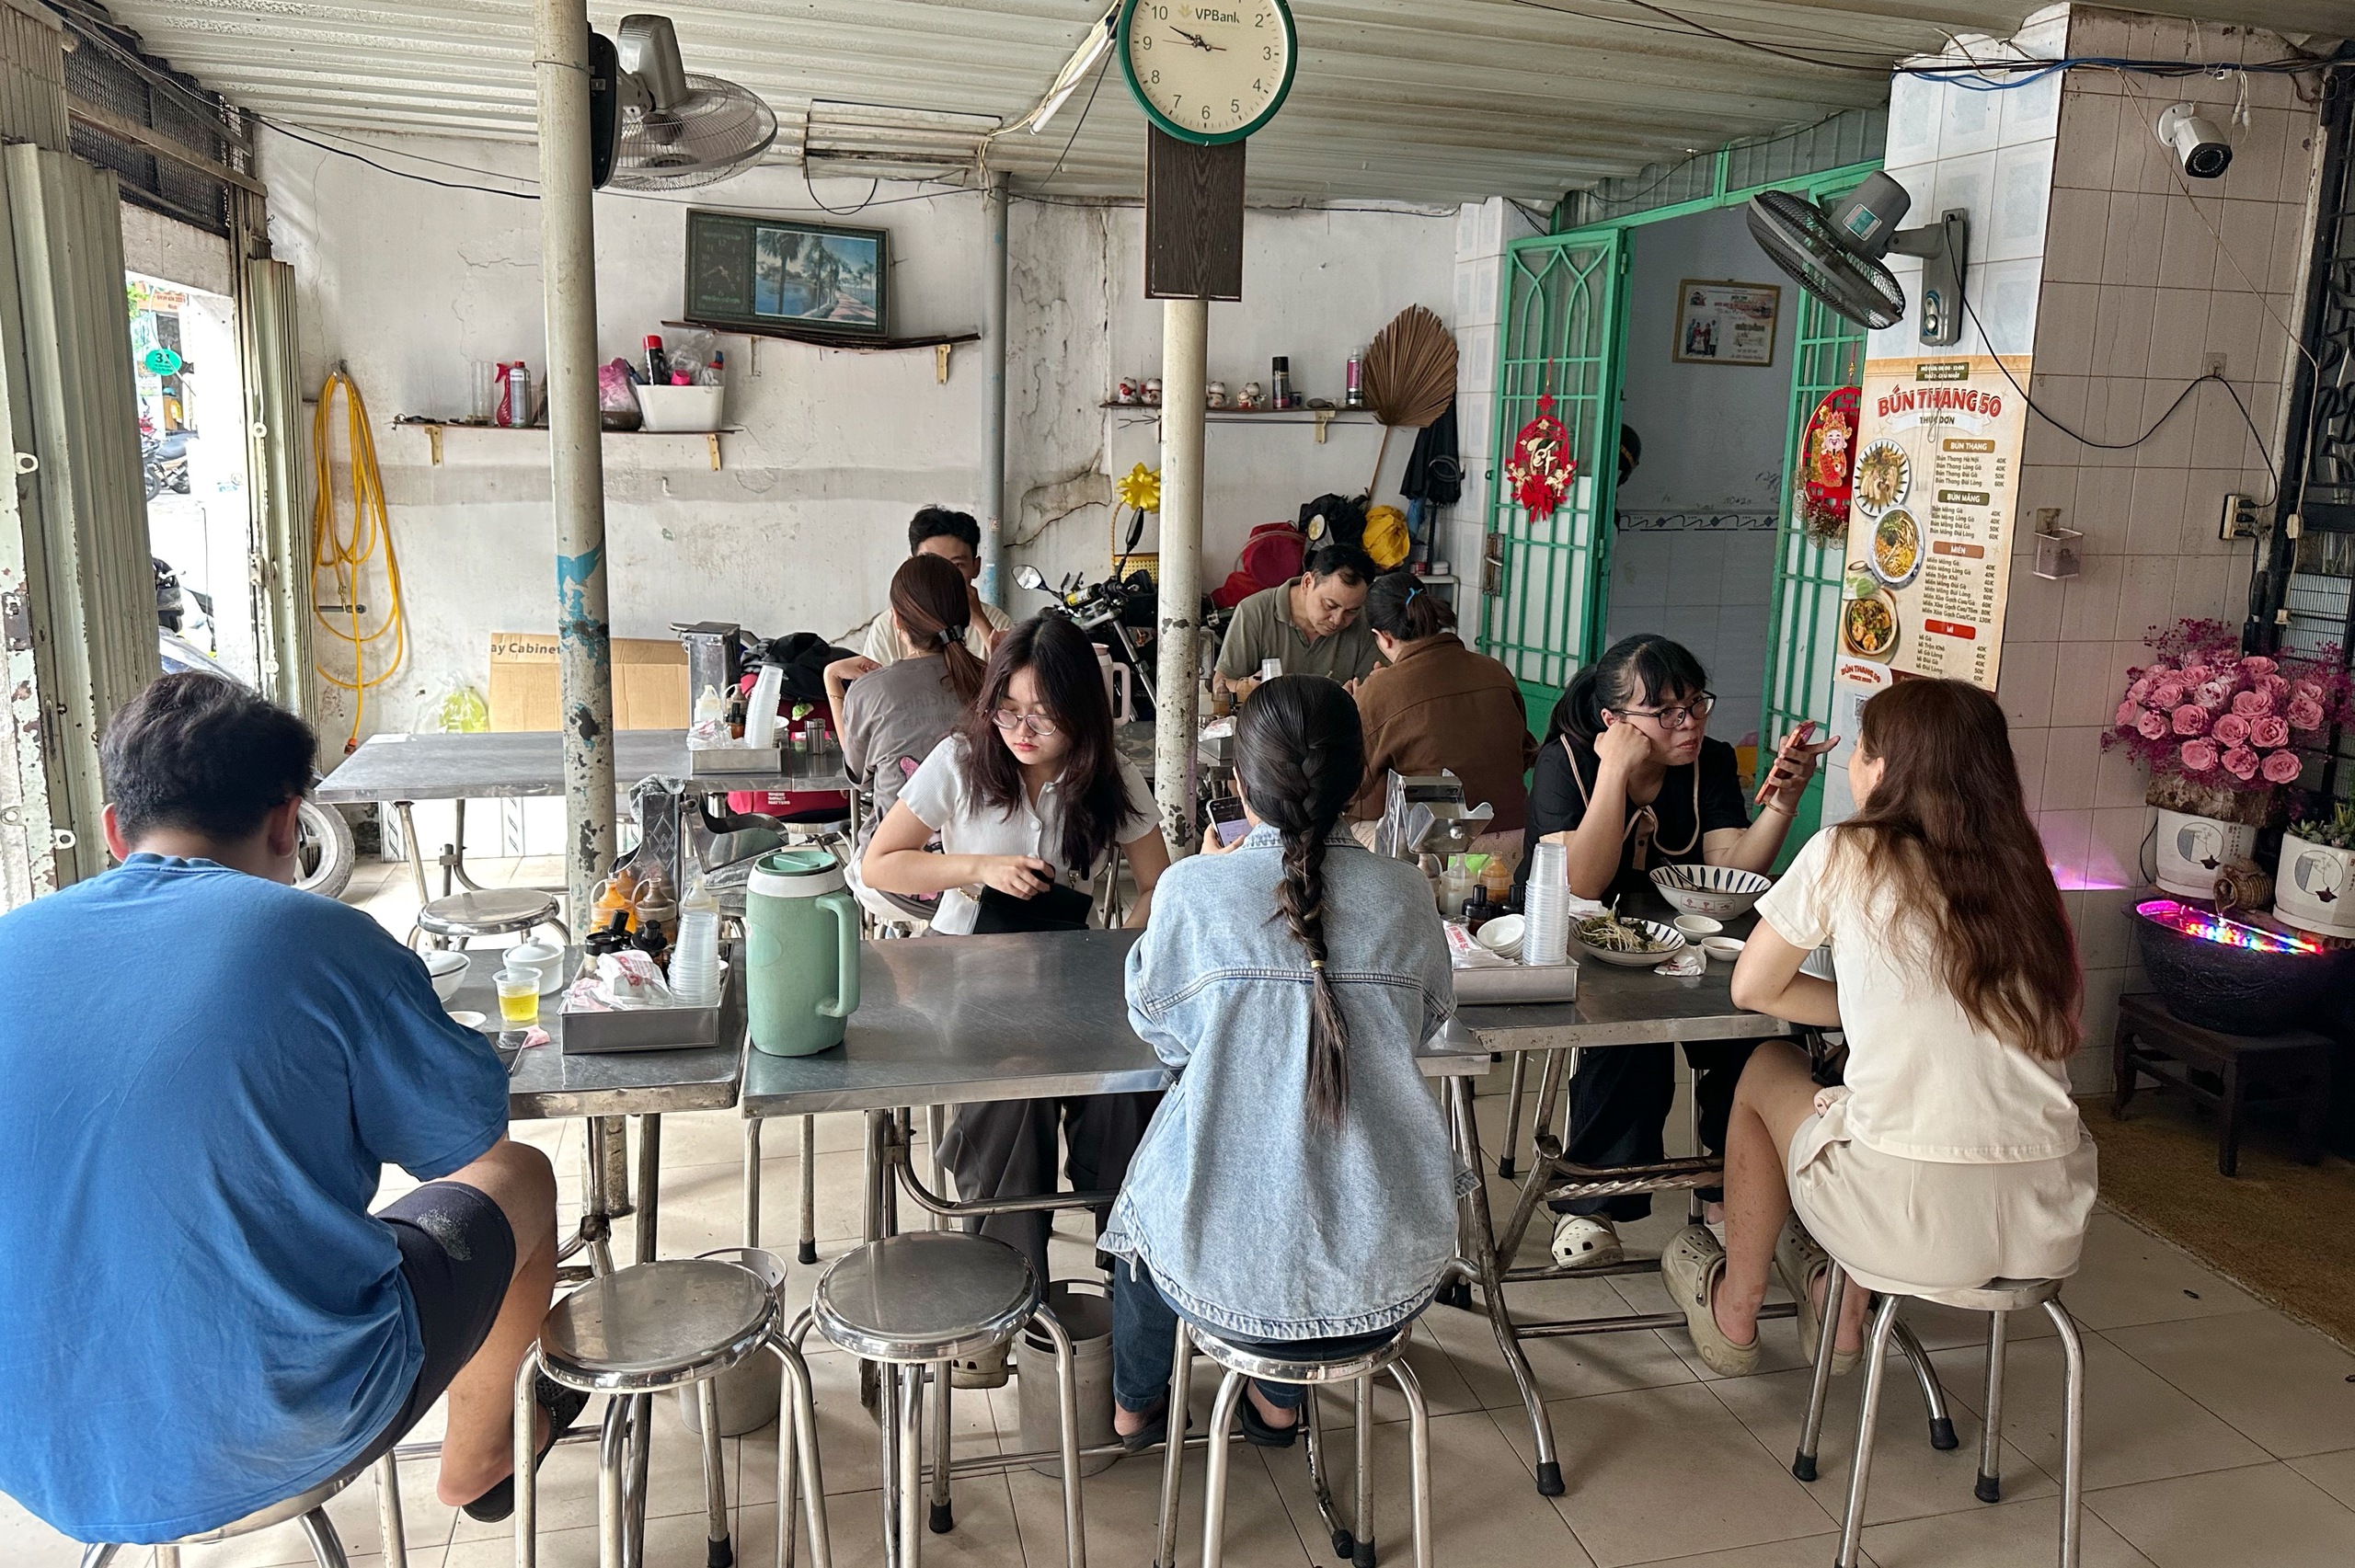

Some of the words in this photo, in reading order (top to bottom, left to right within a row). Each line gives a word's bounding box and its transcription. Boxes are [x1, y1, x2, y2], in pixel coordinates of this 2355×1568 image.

[1151, 6, 1168, 20] 10
[1195, 7, 1240, 24] VPBank
[1255, 14, 1264, 28] 2
[1143, 36, 1152, 51] 9
[1262, 46, 1271, 61] 3
[1151, 70, 1160, 85] 8
[1252, 78, 1261, 92] 4
[1173, 94, 1182, 109] 7
[1231, 98, 1240, 113] 5
[1201, 105, 1211, 120] 6
[1878, 384, 1914, 418] BÚN
[1917, 387, 1978, 412] THANG
[1978, 392, 2002, 418] 50
[1950, 441, 1965, 450] BÚN
[1966, 442, 1987, 451] THANG
[1947, 493, 1960, 501] BÚN
[509, 643, 560, 655] Cabinet
[1854, 665, 1874, 678] THANG
